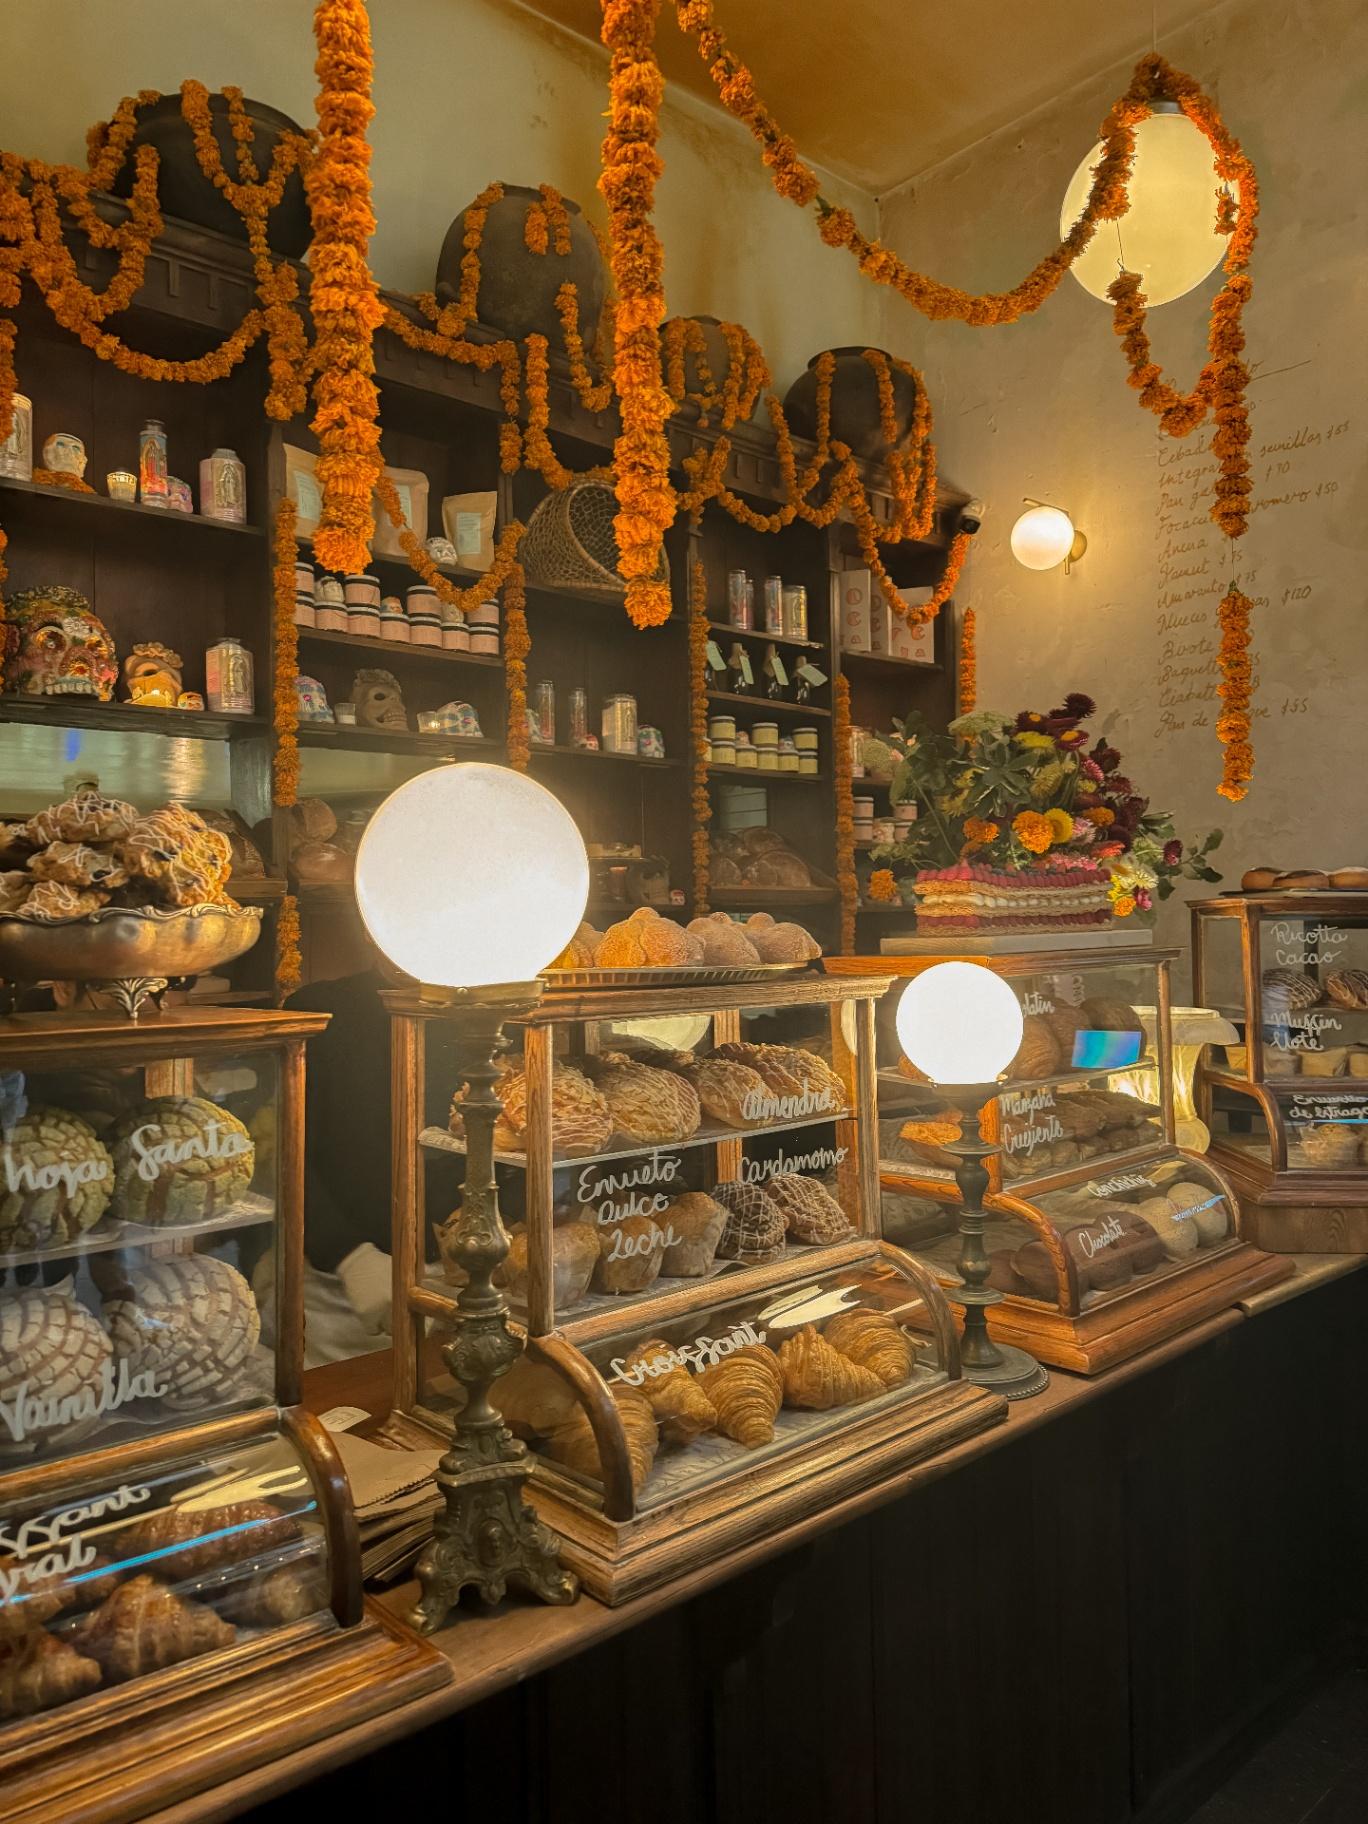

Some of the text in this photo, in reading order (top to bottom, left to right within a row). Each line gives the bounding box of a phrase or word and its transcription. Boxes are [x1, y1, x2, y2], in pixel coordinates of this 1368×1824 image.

[1270, 922, 1348, 945] Ricotta
[1275, 949, 1342, 966] Cacao
[738, 1147, 849, 1184] Cardamomo
[0, 1358, 169, 1442] Vainilla
